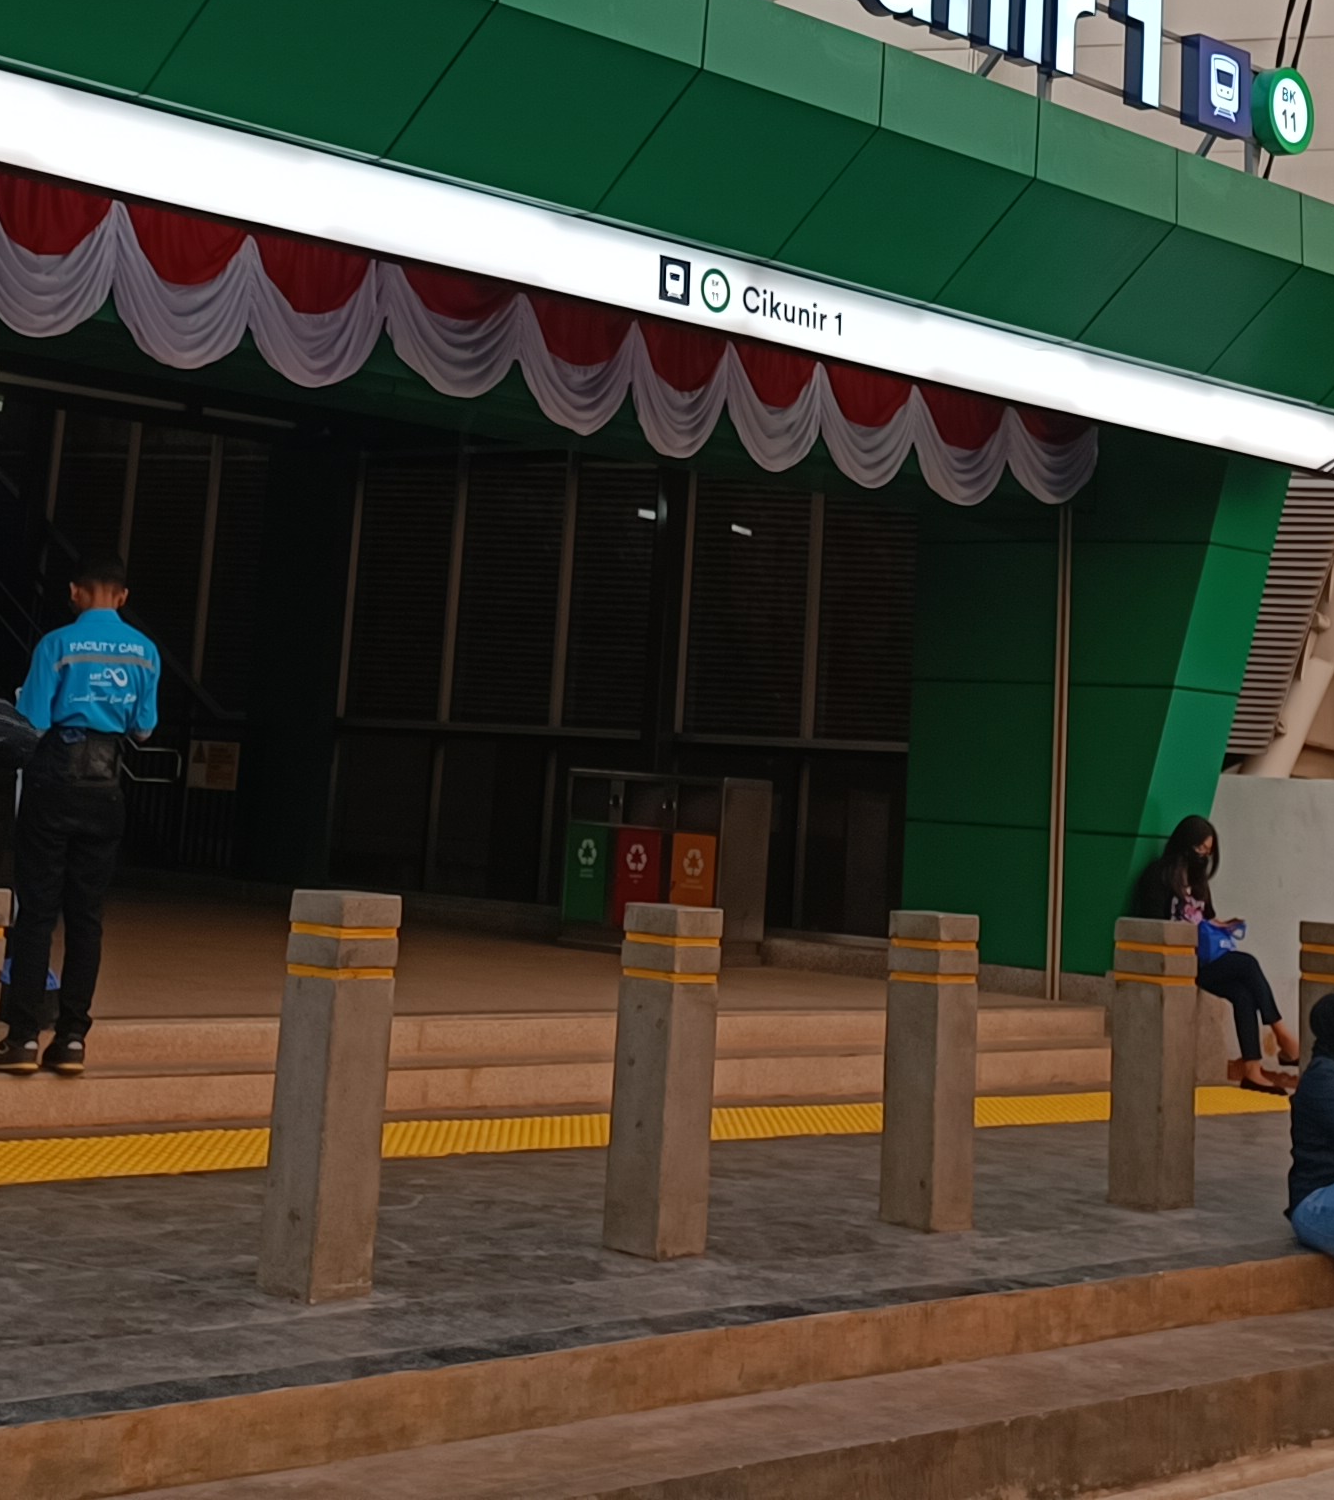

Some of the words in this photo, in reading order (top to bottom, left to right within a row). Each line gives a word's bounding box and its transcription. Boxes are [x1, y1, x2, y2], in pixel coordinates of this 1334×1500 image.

[1281, 86, 1297, 105] BK
[1281, 108, 1297, 133] 11
[742, 286, 828, 332] Cikunir
[834, 312, 843, 336] 1
[69, 641, 117, 653] FACILITY
